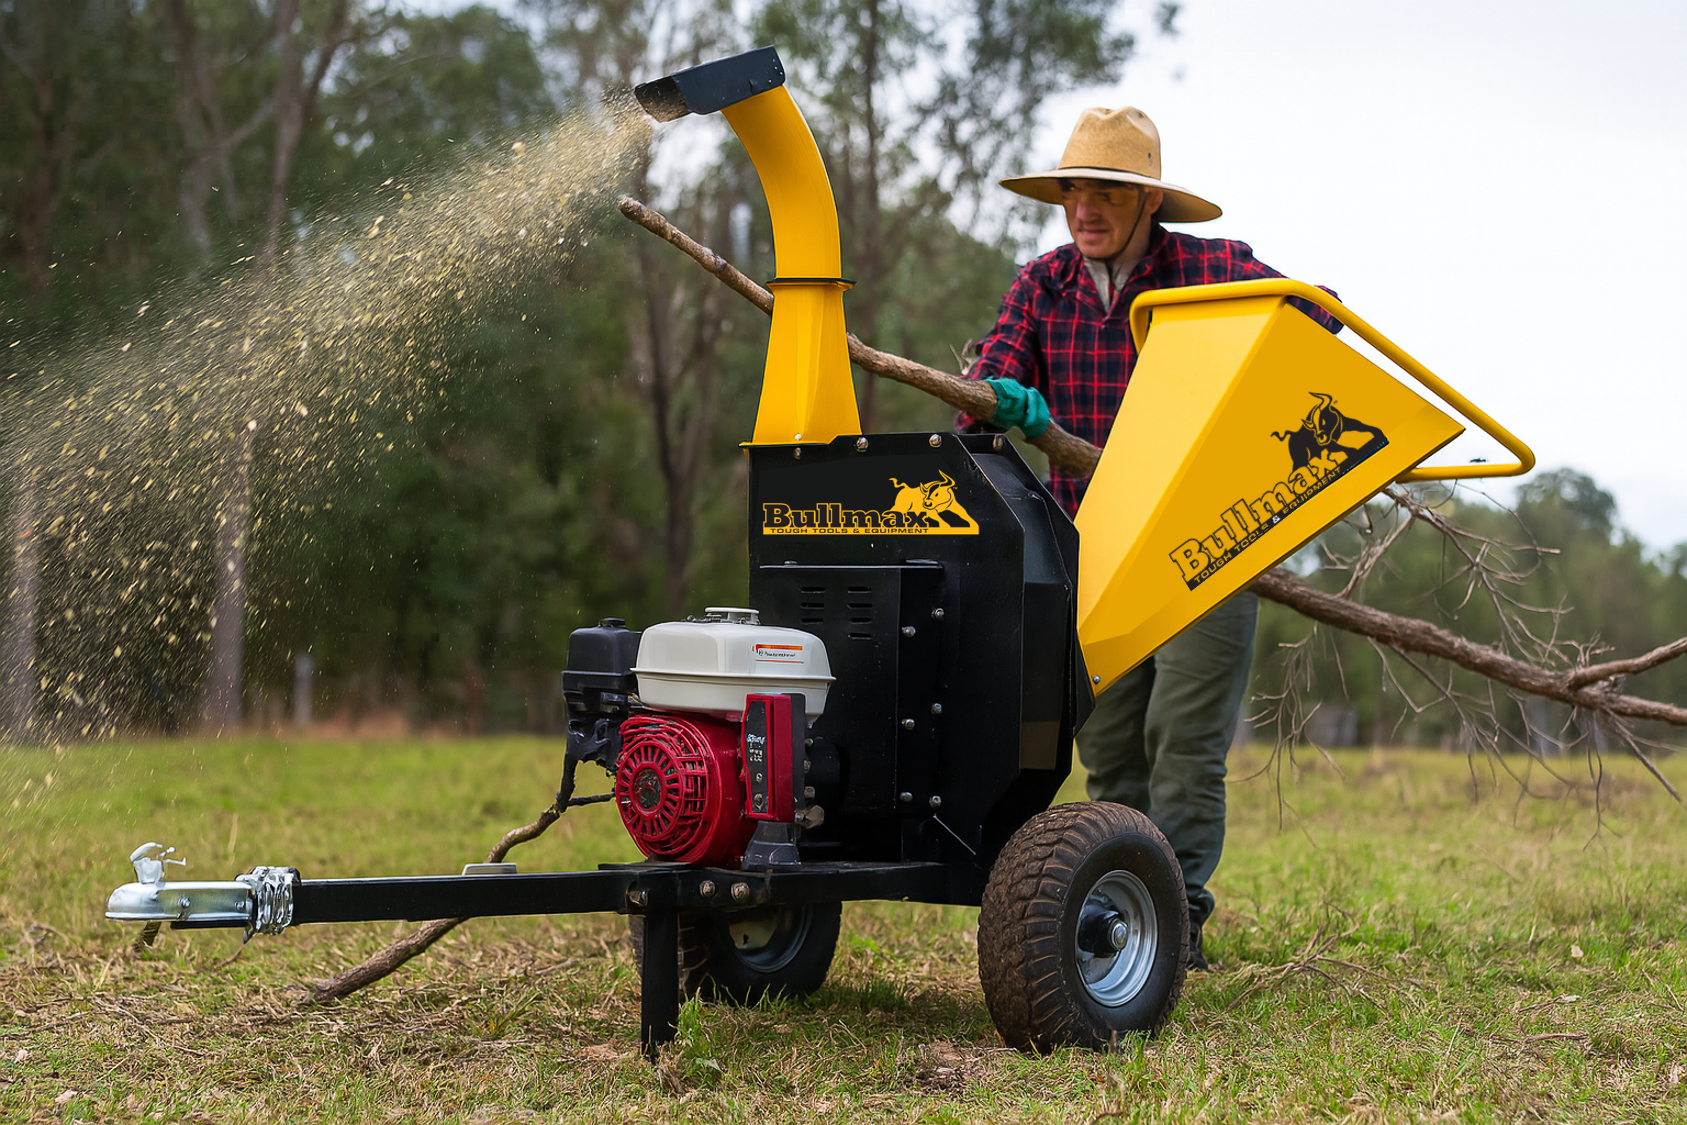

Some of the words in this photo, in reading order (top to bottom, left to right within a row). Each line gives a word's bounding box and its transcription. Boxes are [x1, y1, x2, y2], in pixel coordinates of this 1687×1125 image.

[763, 503, 929, 528] Bullmax
[1168, 448, 1338, 582] Bullmax
[1194, 552, 1233, 584] TOUGH
[1233, 523, 1269, 552] TOOLS
[1272, 515, 1281, 524] &
[1283, 467, 1341, 514] EQUIPMENT
